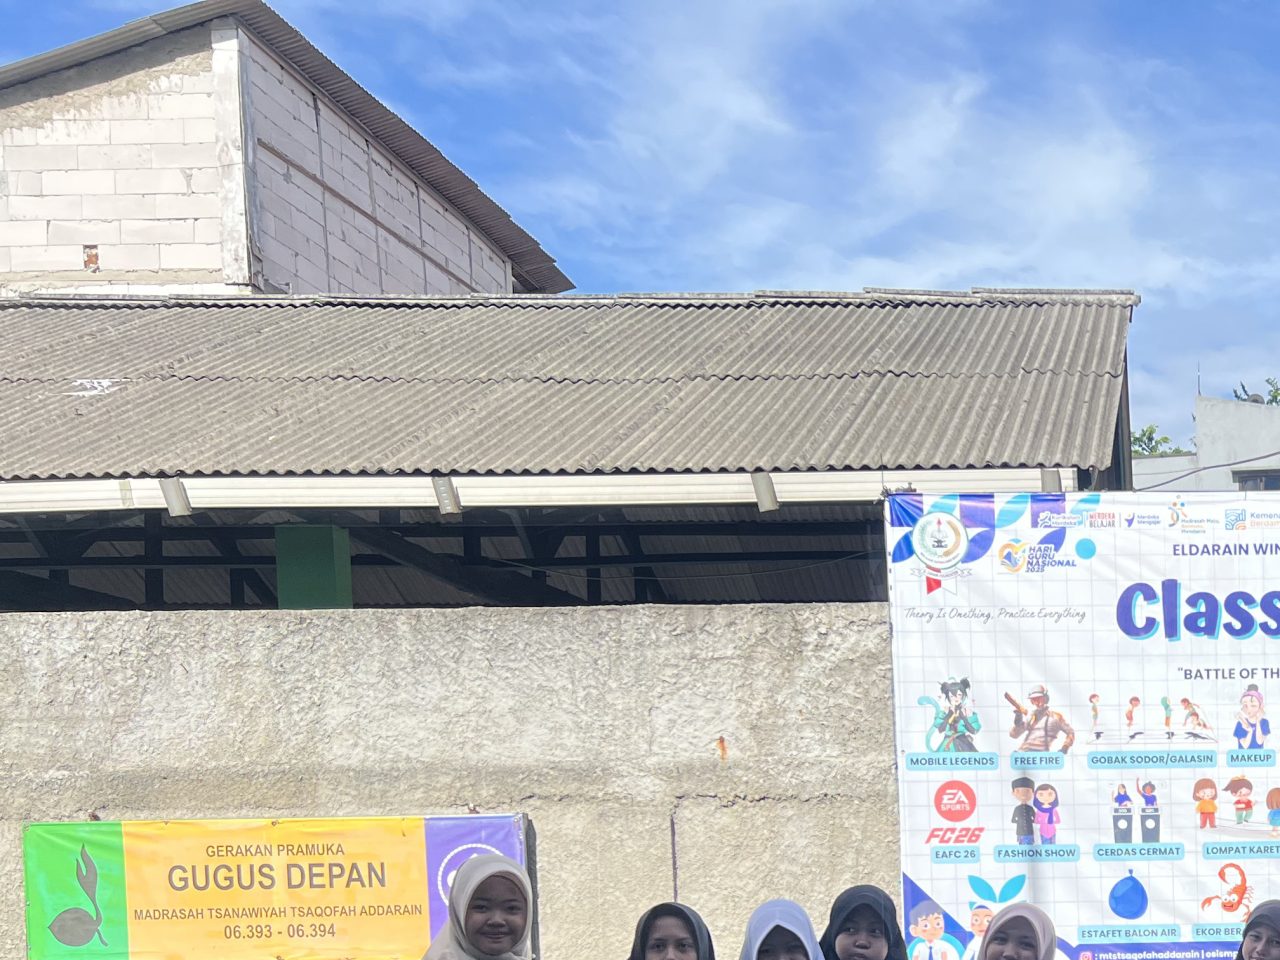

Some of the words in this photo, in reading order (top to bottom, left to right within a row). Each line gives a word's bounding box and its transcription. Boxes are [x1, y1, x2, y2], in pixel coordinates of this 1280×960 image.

[1089, 520, 1116, 528] BELAJAR
[1172, 543, 1249, 556] ELDARAIN
[904, 608, 934, 624] Theory
[936, 608, 948, 619] Is
[998, 607, 1035, 620] Practice
[1037, 607, 1087, 624] Everything
[1239, 667, 1259, 680] OF
[910, 757, 949, 767] MOBILE
[949, 756, 996, 767] LEGENDS
[1014, 756, 1038, 766] FREE
[1039, 756, 1061, 765] FIRE
[1091, 755, 1128, 765] GOBAK
[1129, 753, 1214, 766] SODOR/GALASIN
[1230, 754, 1273, 764] MAKEUP
[940, 789, 969, 804] EA
[940, 803, 971, 812] SPORTS
[205, 844, 274, 858] GERAKAN
[276, 843, 345, 857] PRAMUKA
[934, 850, 962, 859] EAFC
[963, 849, 977, 859] 26
[997, 849, 1043, 859] FASHION
[1044, 848, 1077, 858] SHOW
[1096, 847, 1137, 858] CERDAS
[1138, 846, 1181, 857] CERMAT
[1205, 846, 1247, 856] LOMPAT
[1249, 844, 1280, 855] KARET
[167, 863, 276, 893] GUGUS
[286, 861, 387, 890] DEPAN
[133, 908, 204, 922] MADRASAH
[206, 906, 287, 921] TSANAWIYAH
[290, 905, 357, 921] TSAQOFAH
[359, 904, 423, 918] ADDARAIN
[223, 925, 273, 940] 06.393
[286, 924, 337, 939] 06.394
[1081, 929, 1123, 939] ESTAFET
[1123, 928, 1159, 938] BALON
[1160, 928, 1177, 938] AIR
[1195, 927, 1223, 937] EKOR
[1223, 925, 1243, 936] BER
